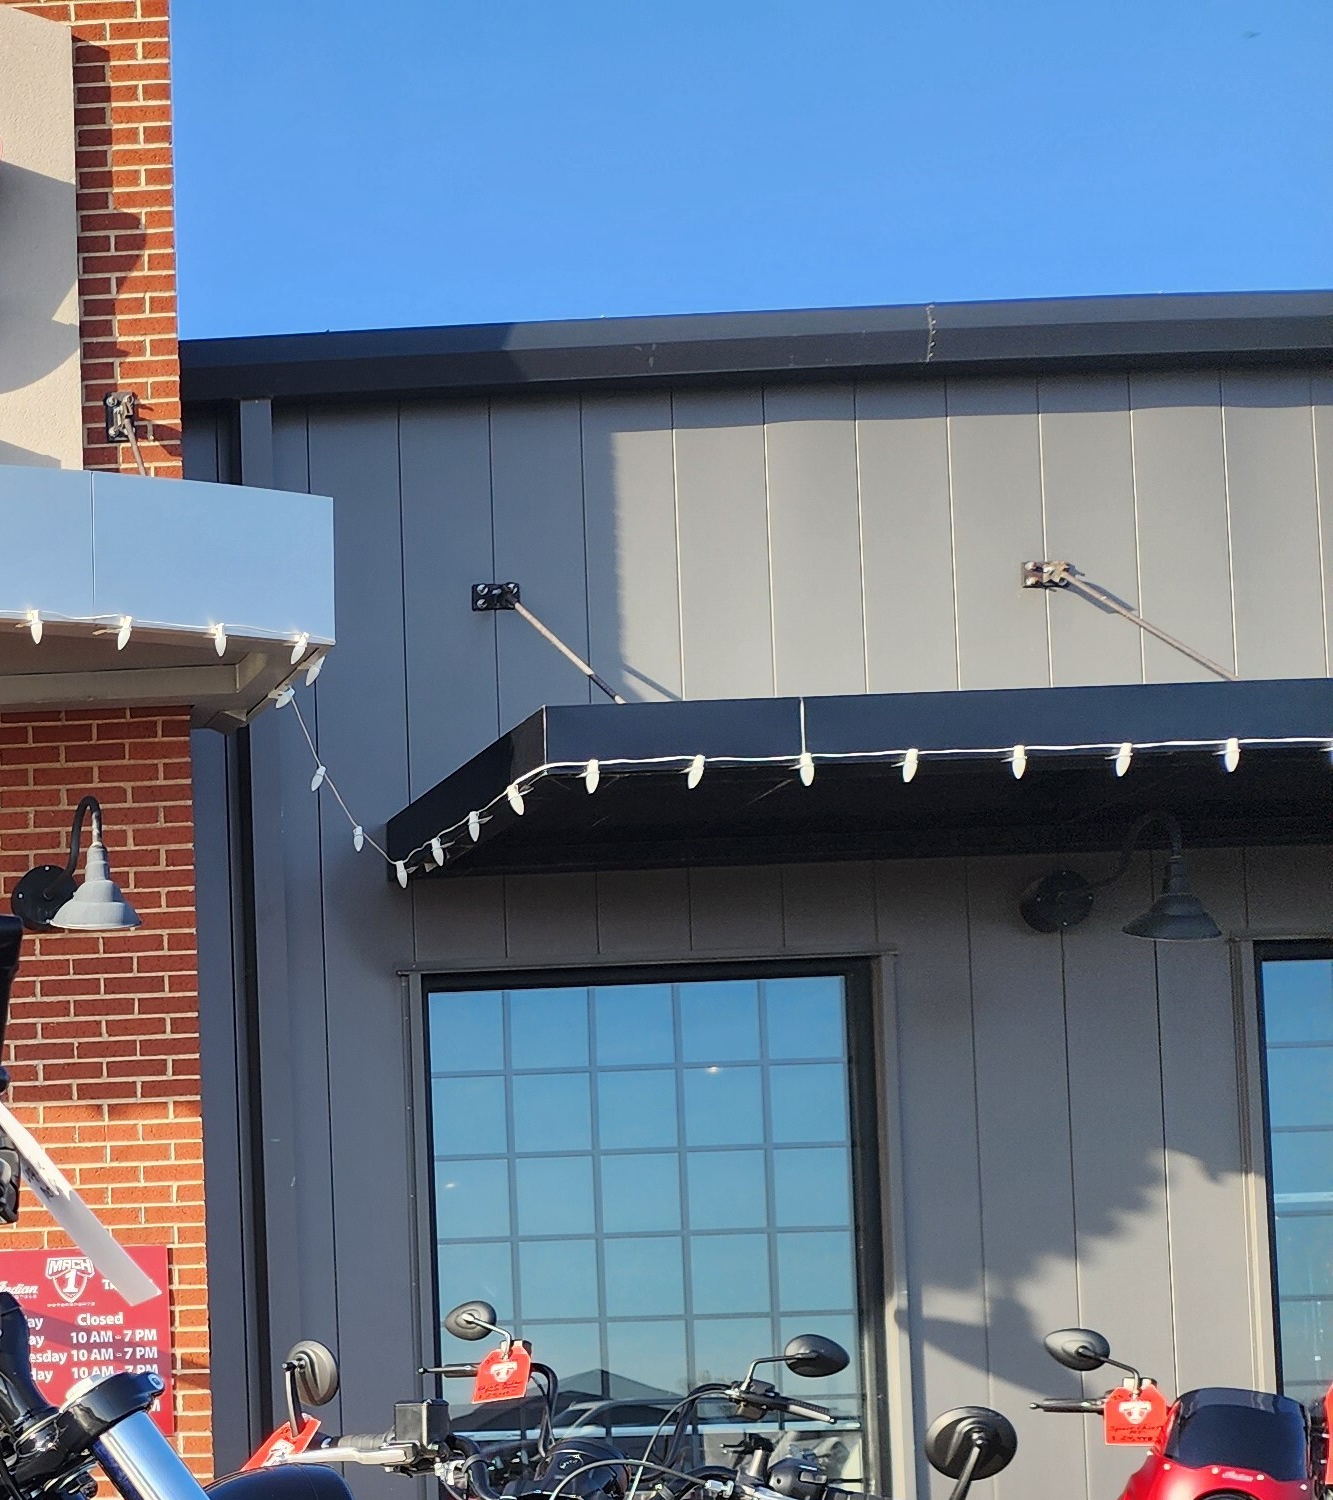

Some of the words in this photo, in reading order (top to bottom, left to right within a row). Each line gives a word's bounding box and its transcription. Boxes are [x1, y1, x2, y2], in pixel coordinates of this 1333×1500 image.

[49, 1259, 93, 1275] MACH
[63, 1270, 78, 1293] 1
[77, 1312, 123, 1325] Closed
[71, 1332, 87, 1344] 10
[90, 1331, 113, 1343] AM
[124, 1331, 132, 1342] 7
[135, 1329, 157, 1341] PM
[29, 1350, 67, 1364] esday
[71, 1350, 88, 1361] 10
[90, 1349, 113, 1361] AM
[124, 1349, 133, 1360] 7
[136, 1347, 158, 1359] PM
[72, 1366, 88, 1378] 10
